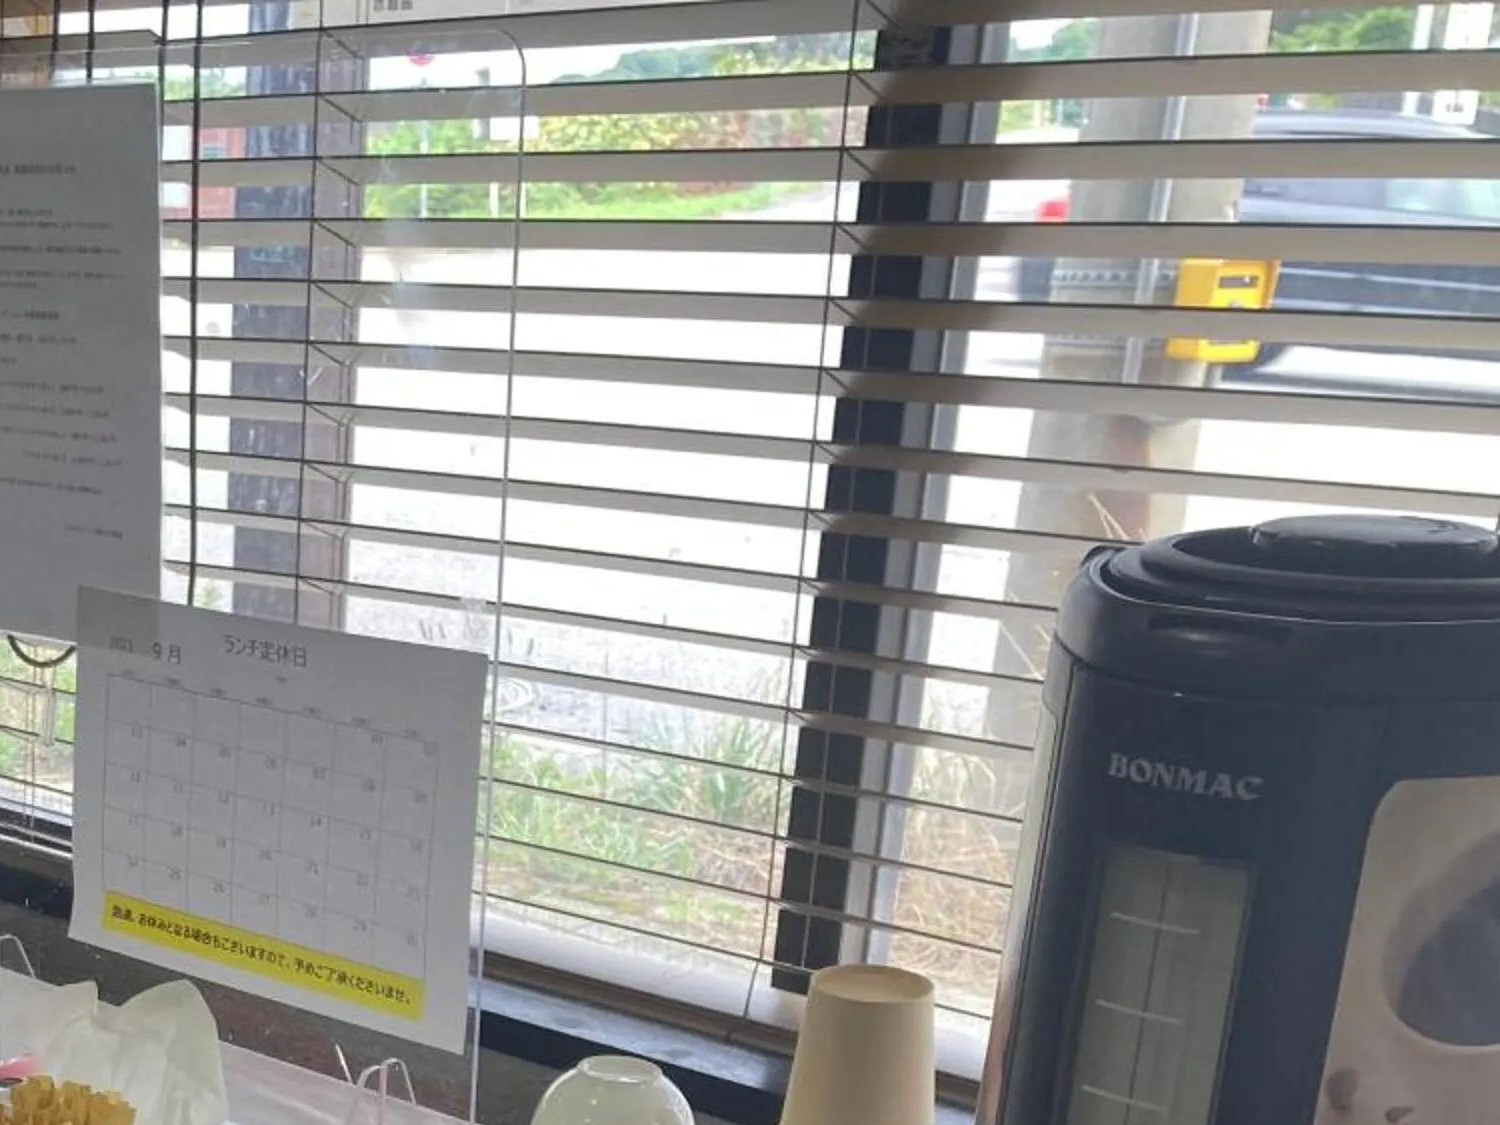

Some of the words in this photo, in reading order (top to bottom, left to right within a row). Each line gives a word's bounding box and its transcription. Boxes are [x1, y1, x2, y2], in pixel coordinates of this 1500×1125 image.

[222, 634, 308, 668] ランチ定休日
[1107, 752, 1265, 801] BONMAC
